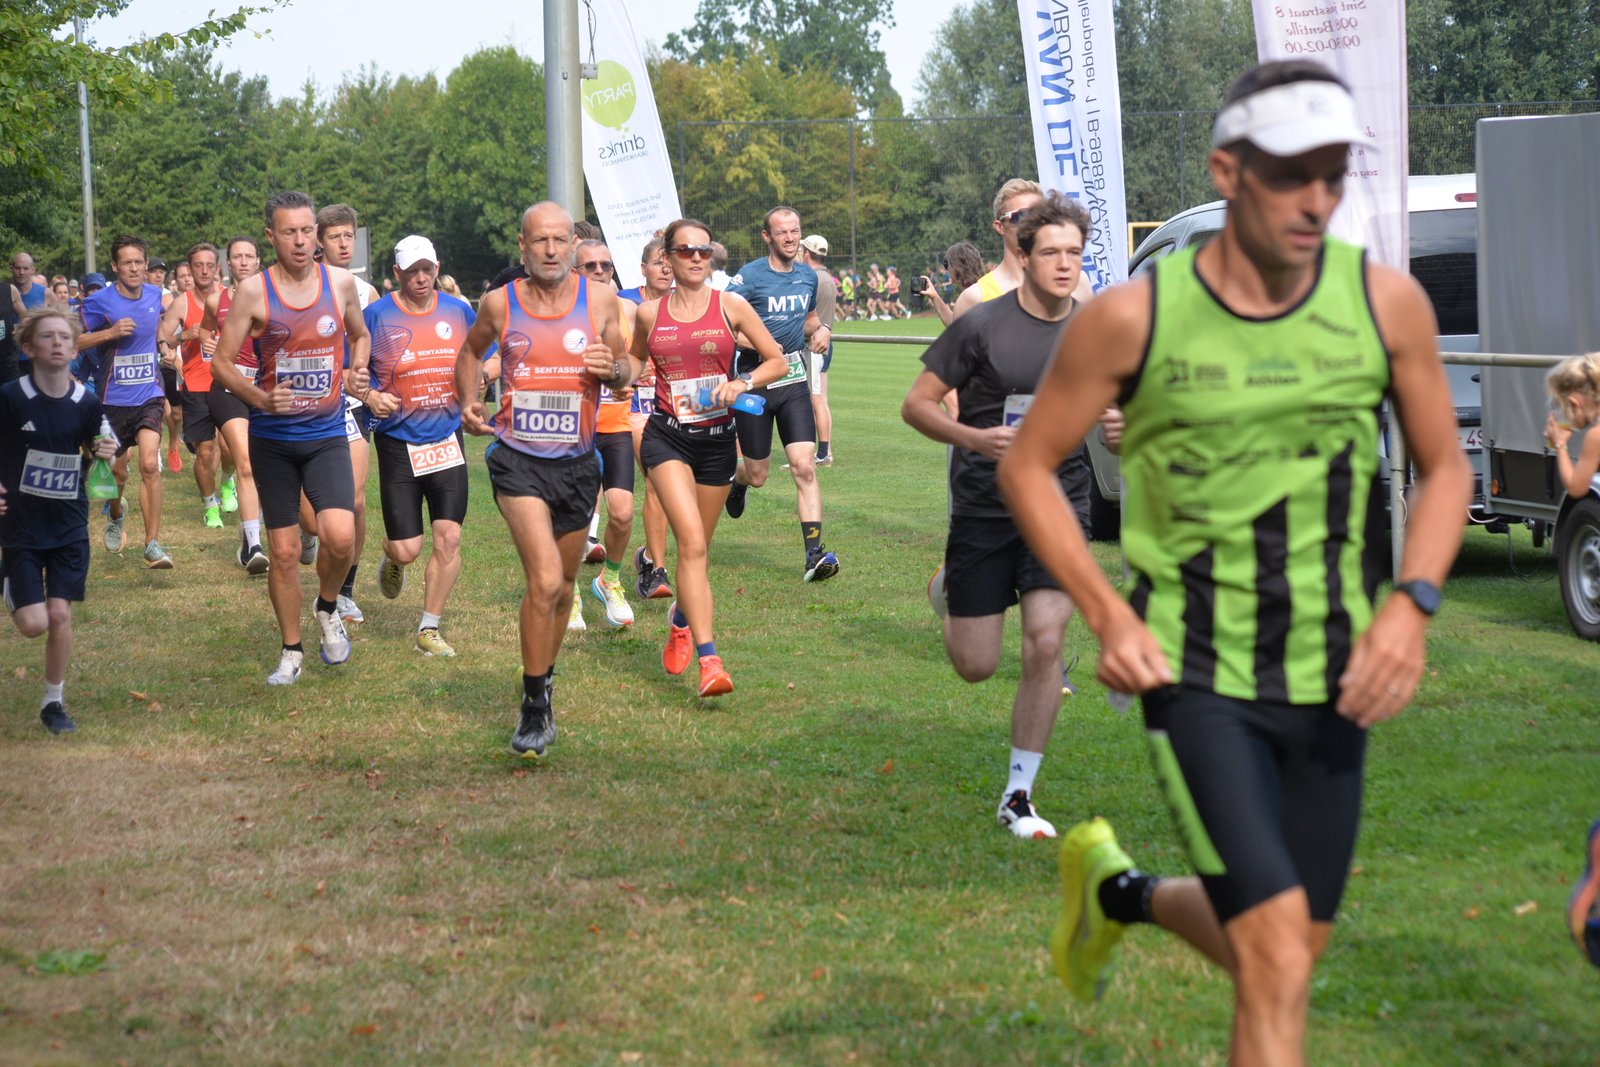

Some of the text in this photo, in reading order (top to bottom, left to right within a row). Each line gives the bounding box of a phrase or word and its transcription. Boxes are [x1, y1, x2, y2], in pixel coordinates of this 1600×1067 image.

[768, 294, 809, 313] MTV
[417, 348, 455, 357] SENTASSUR
[118, 365, 152, 379] 1073
[787, 363, 805, 378] 34
[280, 373, 329, 389] 1003
[516, 411, 576, 433] 1008
[413, 445, 458, 468] 2039
[30, 469, 76, 490] 1114
